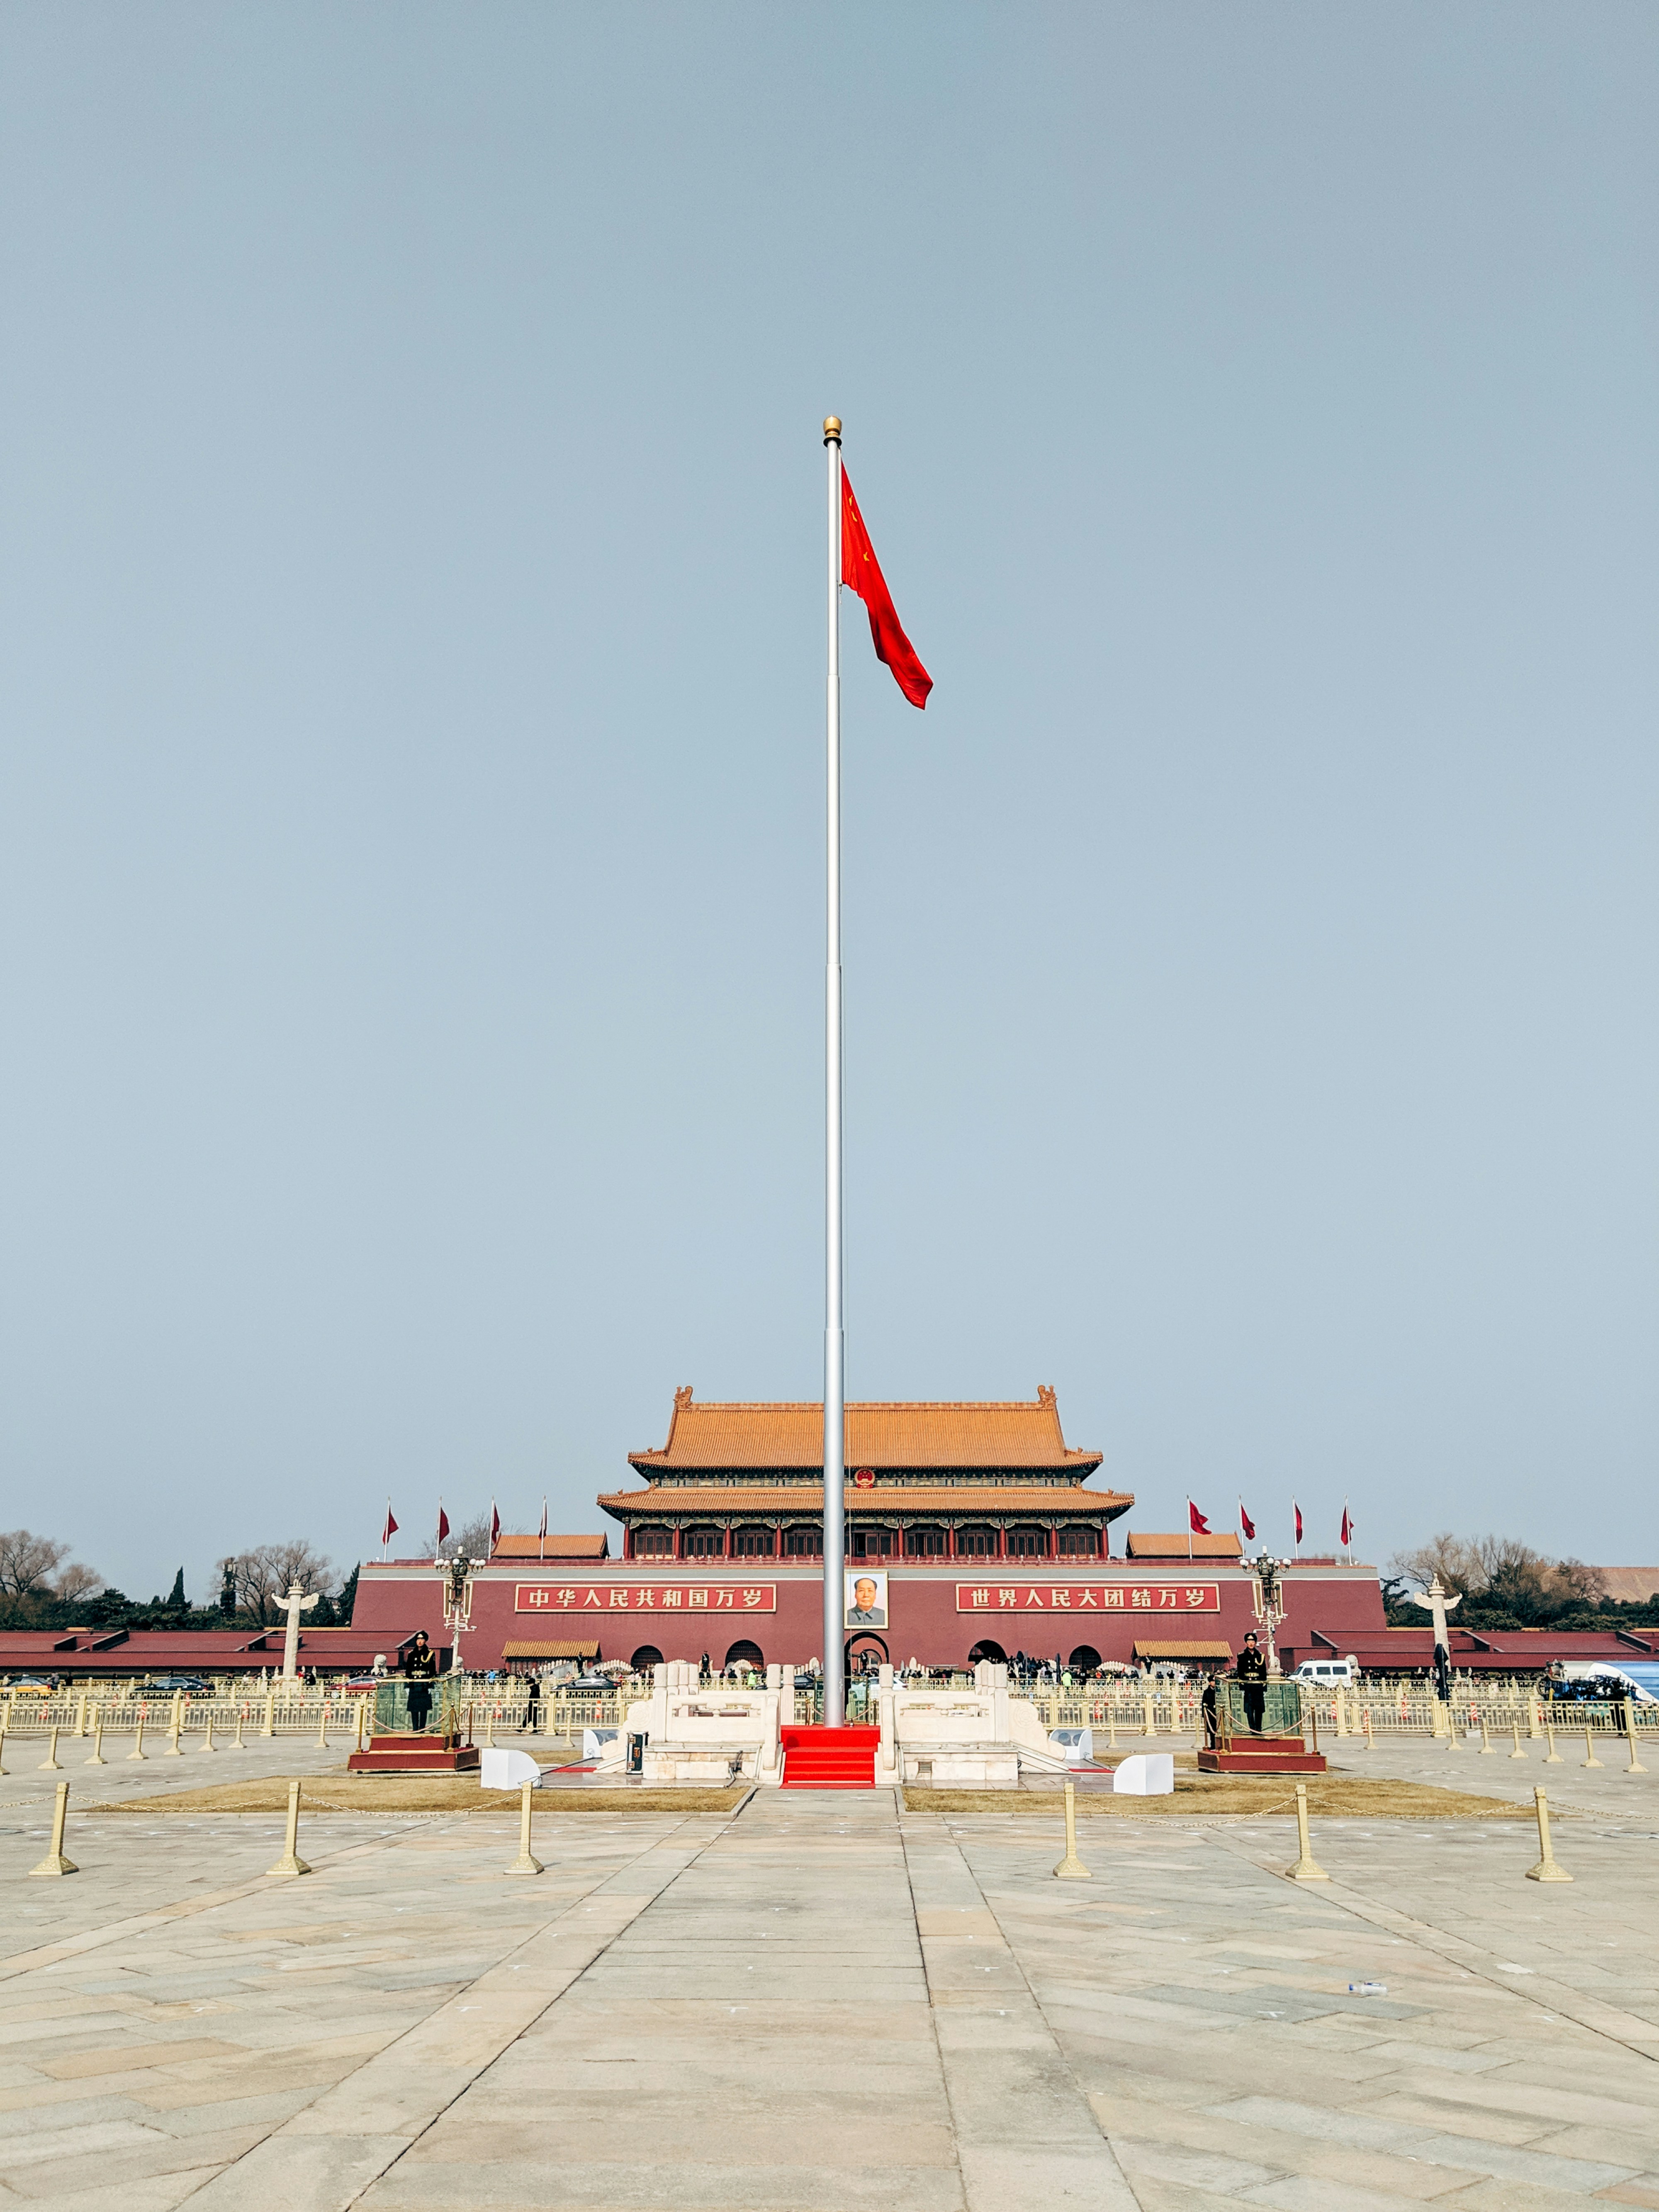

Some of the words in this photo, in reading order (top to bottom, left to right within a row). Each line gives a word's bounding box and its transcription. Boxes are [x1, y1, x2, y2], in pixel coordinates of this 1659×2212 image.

[529, 1589, 762, 1607] 中华人民共和国万岁
[971, 1589, 1205, 1607] 世界人民大团结万岁
